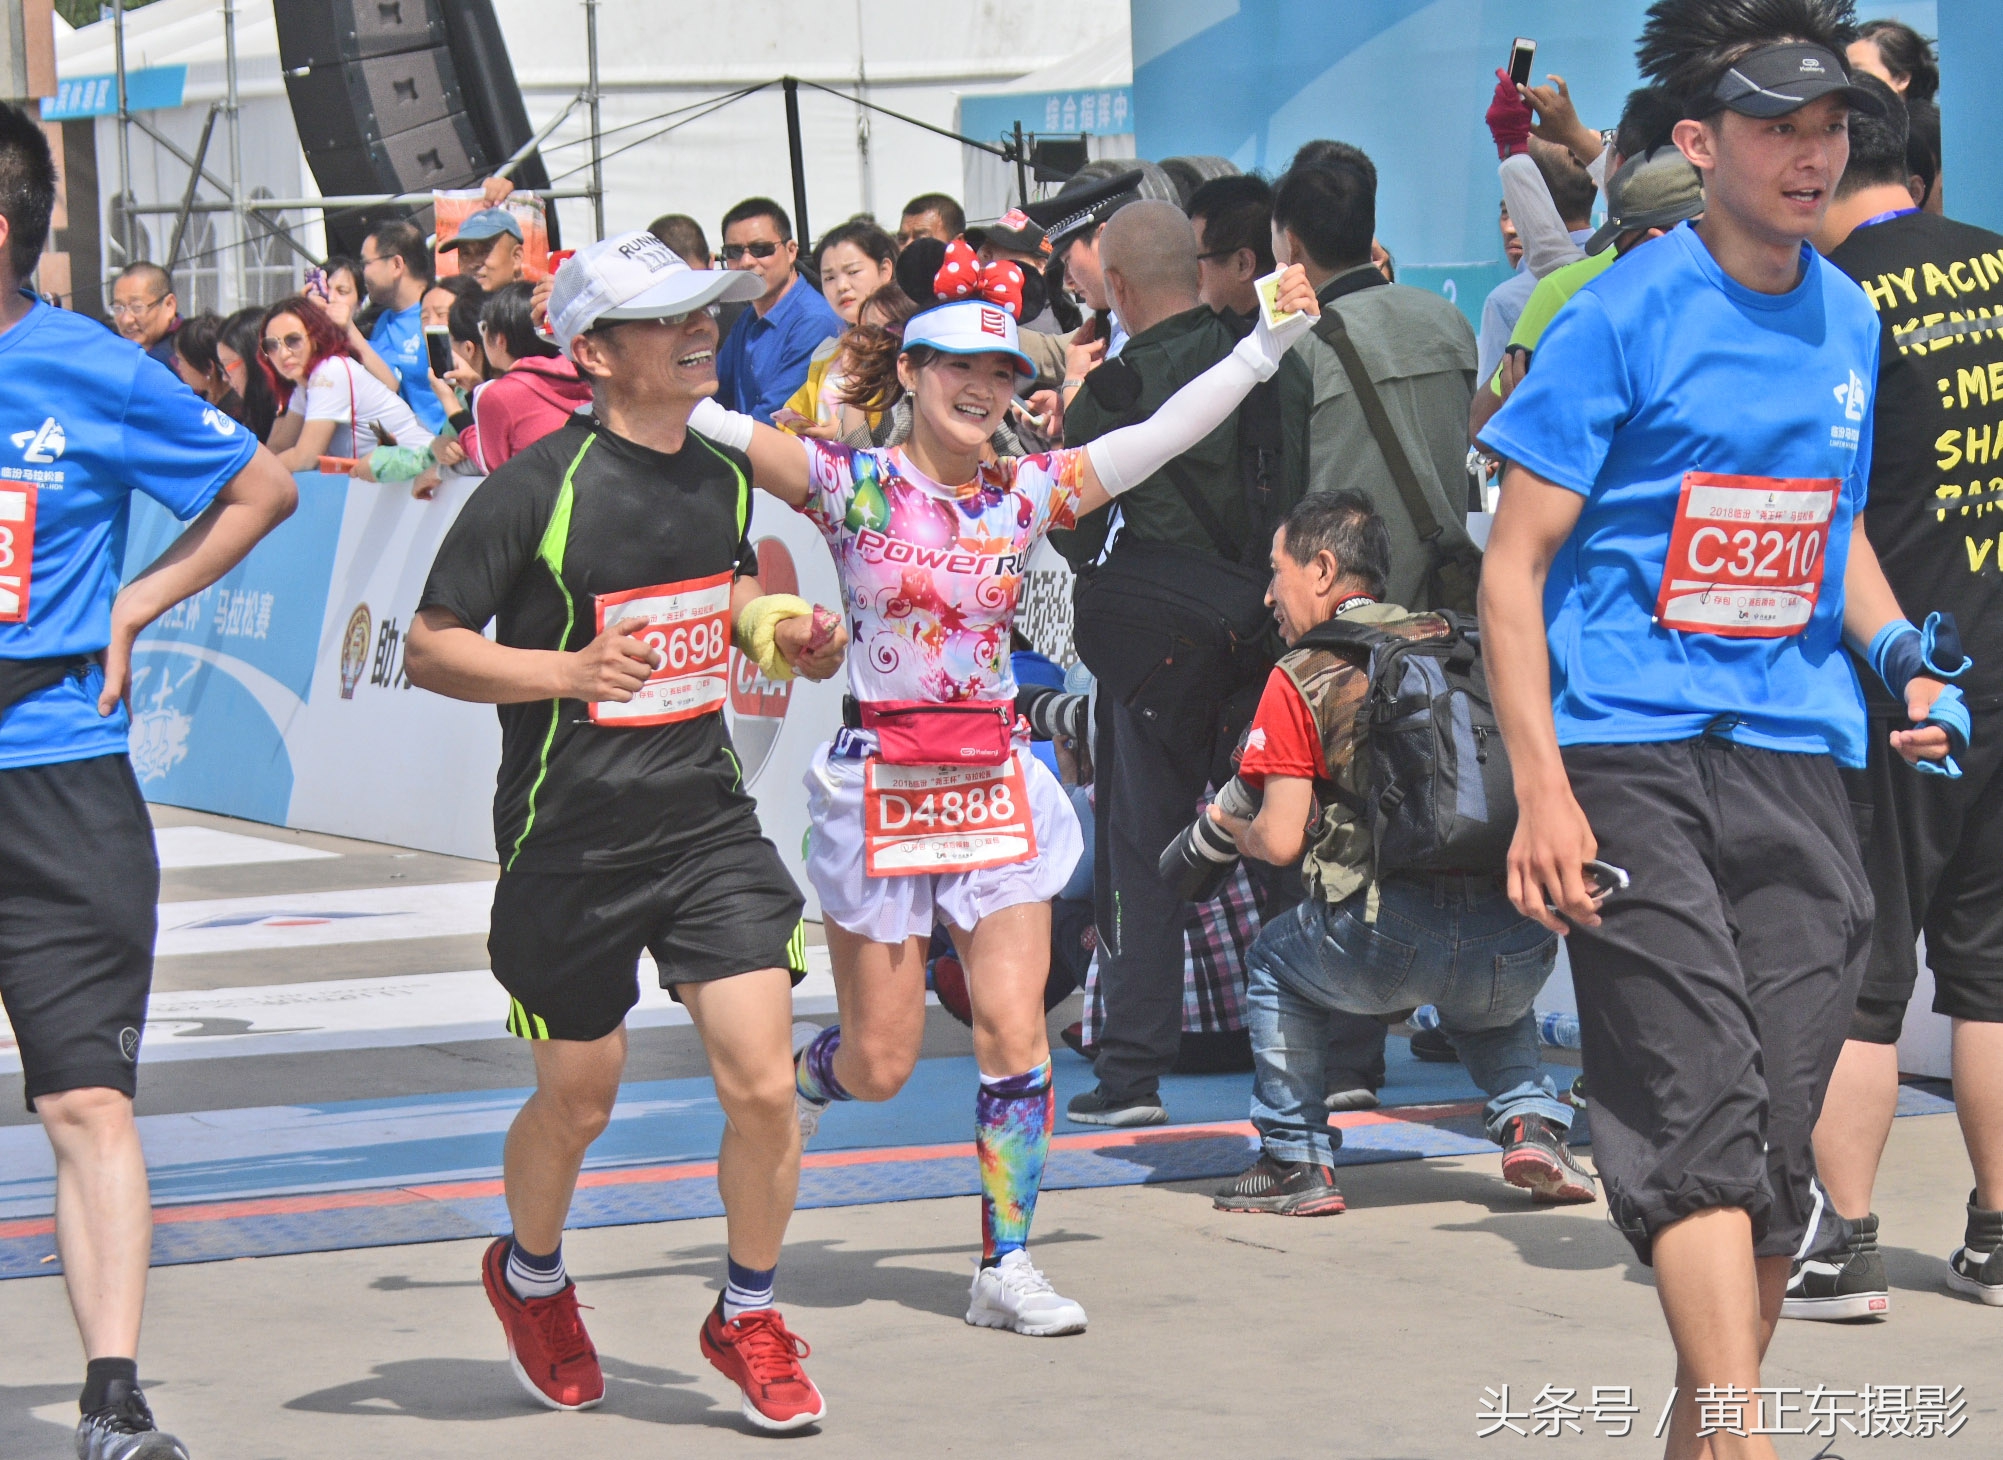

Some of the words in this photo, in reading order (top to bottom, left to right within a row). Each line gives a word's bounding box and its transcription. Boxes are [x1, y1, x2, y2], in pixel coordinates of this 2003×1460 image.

[1, 466, 65, 483] 临汾马拉松赛
[1709, 506, 1751, 520] 2018临汾
[1688, 526, 1820, 578] C3210
[213, 589, 274, 640] 马拉松赛
[627, 618, 724, 672] 3698
[880, 783, 1015, 830] D4888
